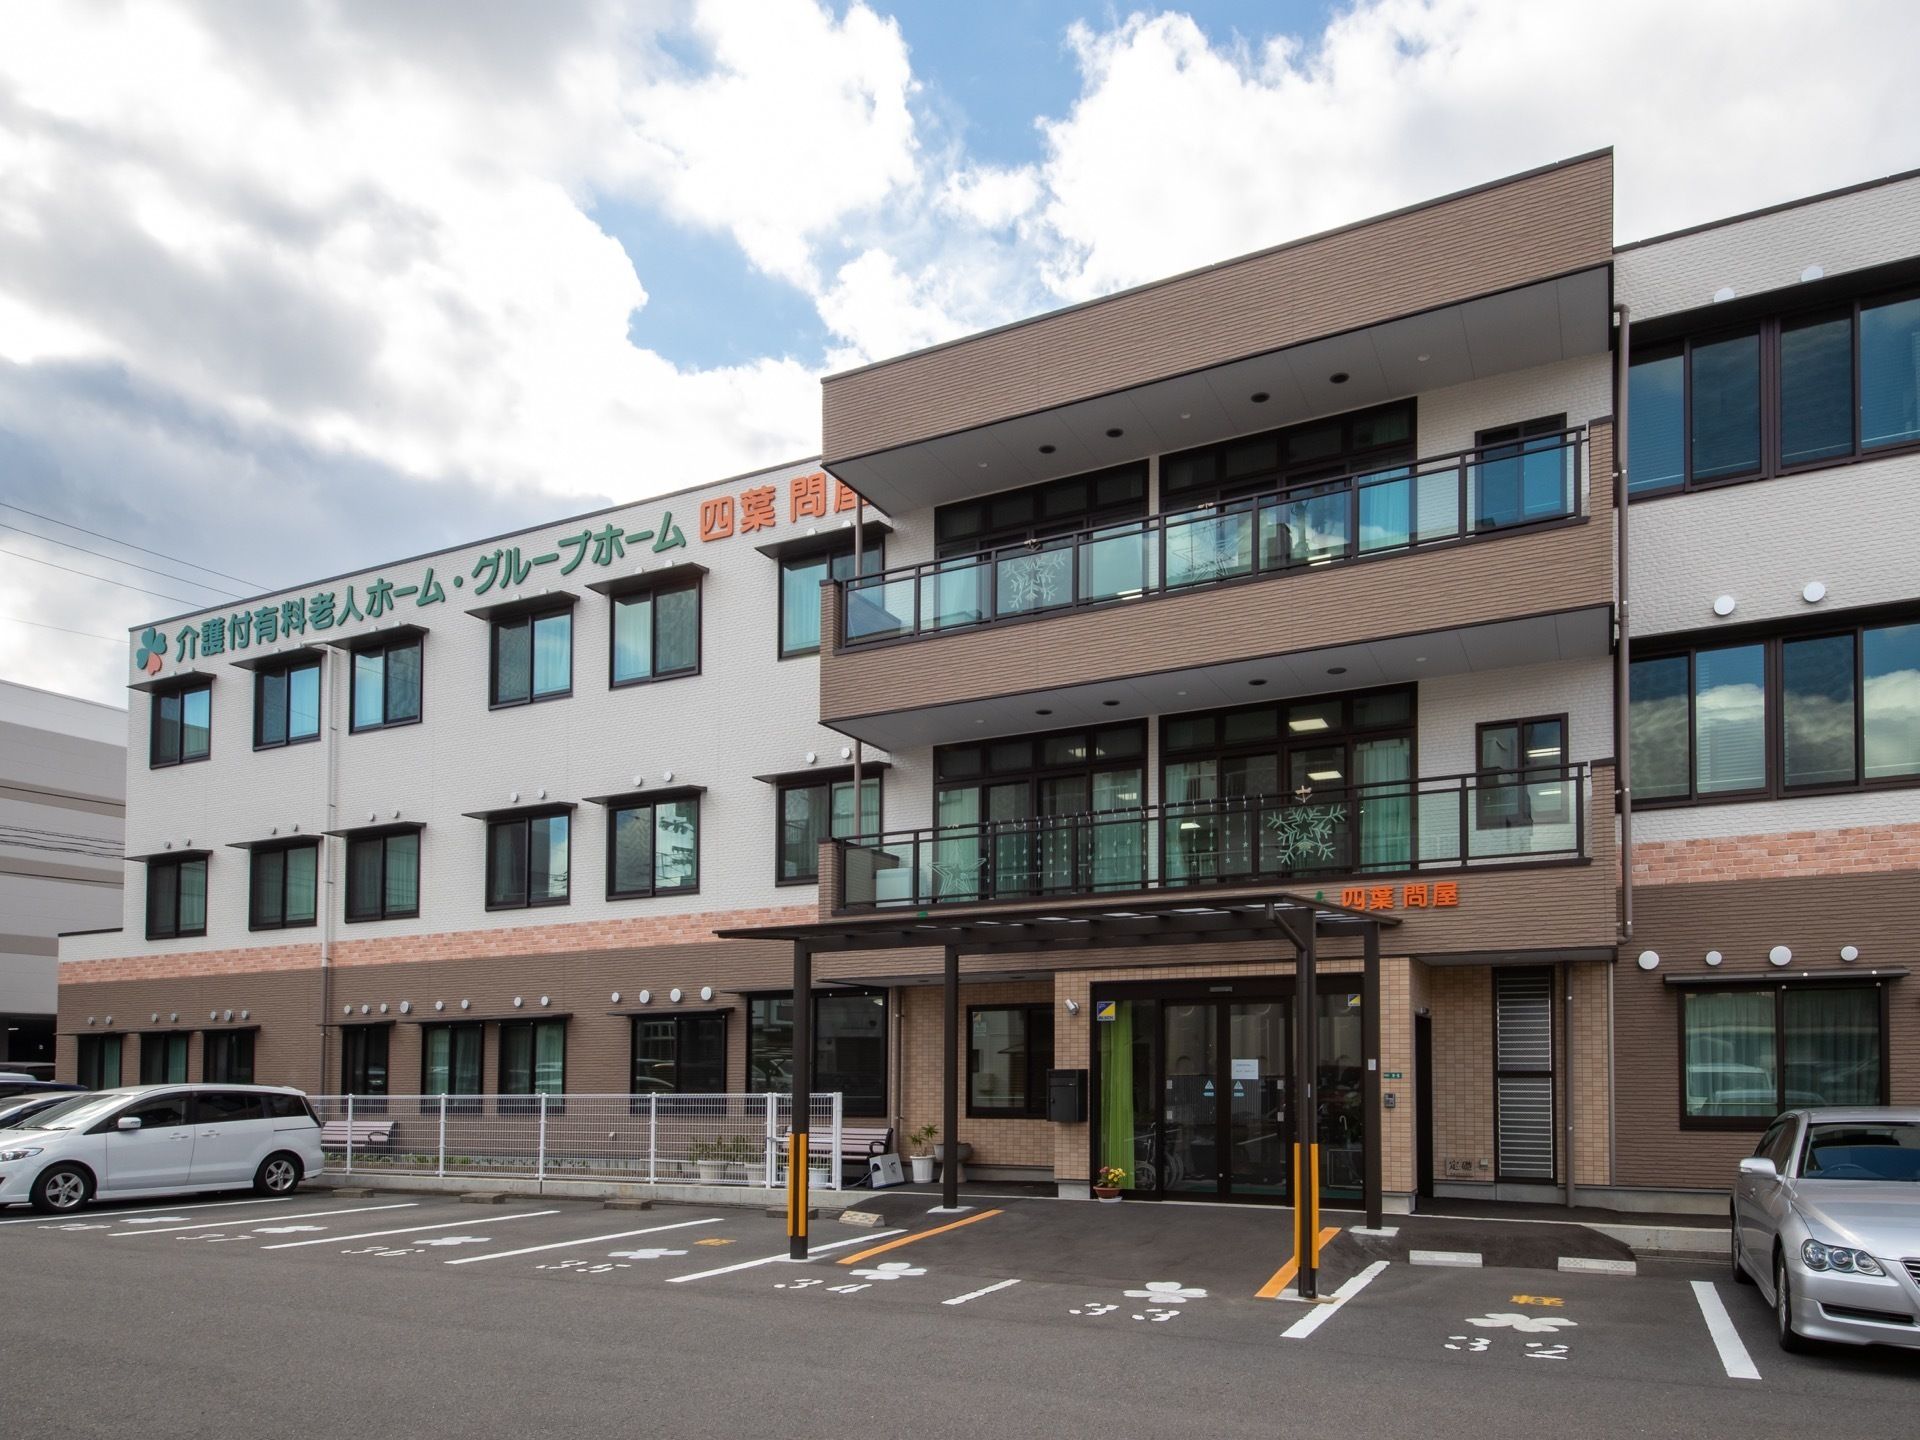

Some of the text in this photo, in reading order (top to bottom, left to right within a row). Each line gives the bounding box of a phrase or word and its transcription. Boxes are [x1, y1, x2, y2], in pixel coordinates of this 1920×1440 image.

[535, 1259, 632, 1273] 35
[1068, 1302, 1181, 1322] 33
[1444, 1335, 1570, 1360] 32
